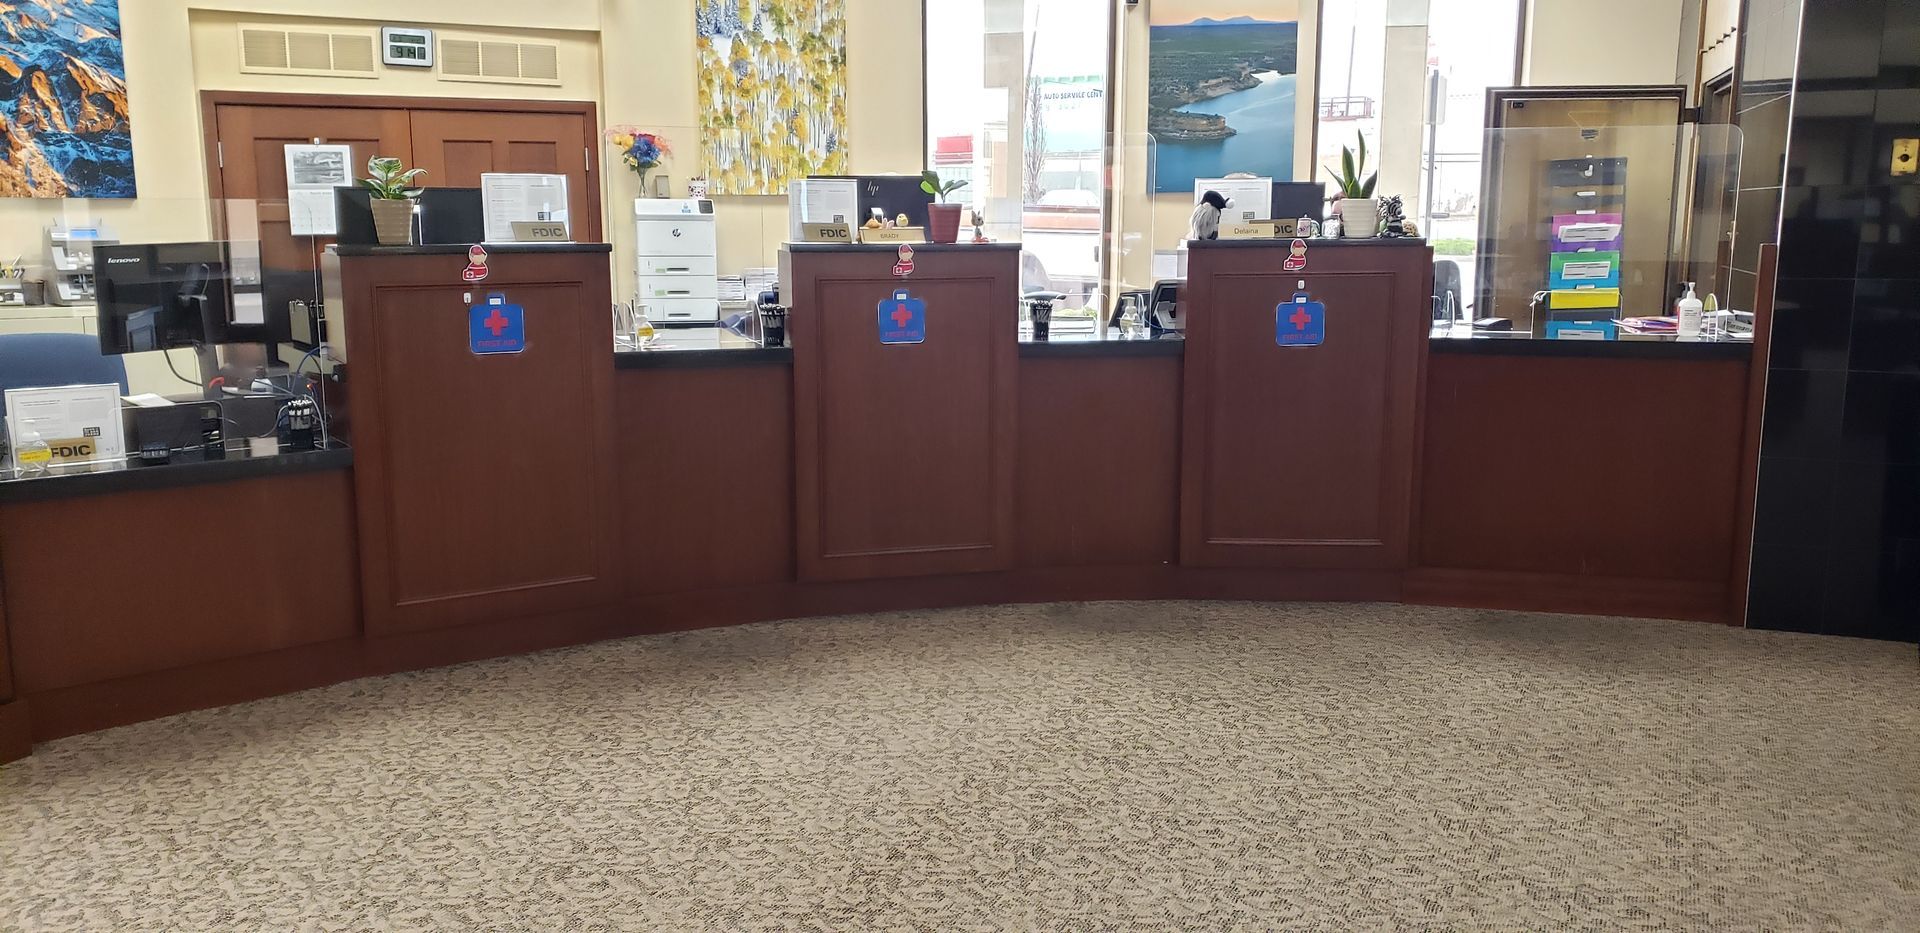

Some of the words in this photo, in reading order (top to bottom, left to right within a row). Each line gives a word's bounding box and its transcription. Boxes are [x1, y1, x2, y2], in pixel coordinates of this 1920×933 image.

[1060, 91, 1085, 99] SERVICE
[532, 227, 563, 237] FDIC
[820, 228, 847, 239] FDIC
[1274, 224, 1293, 234] DIC
[51, 445, 91, 458] FDIC
